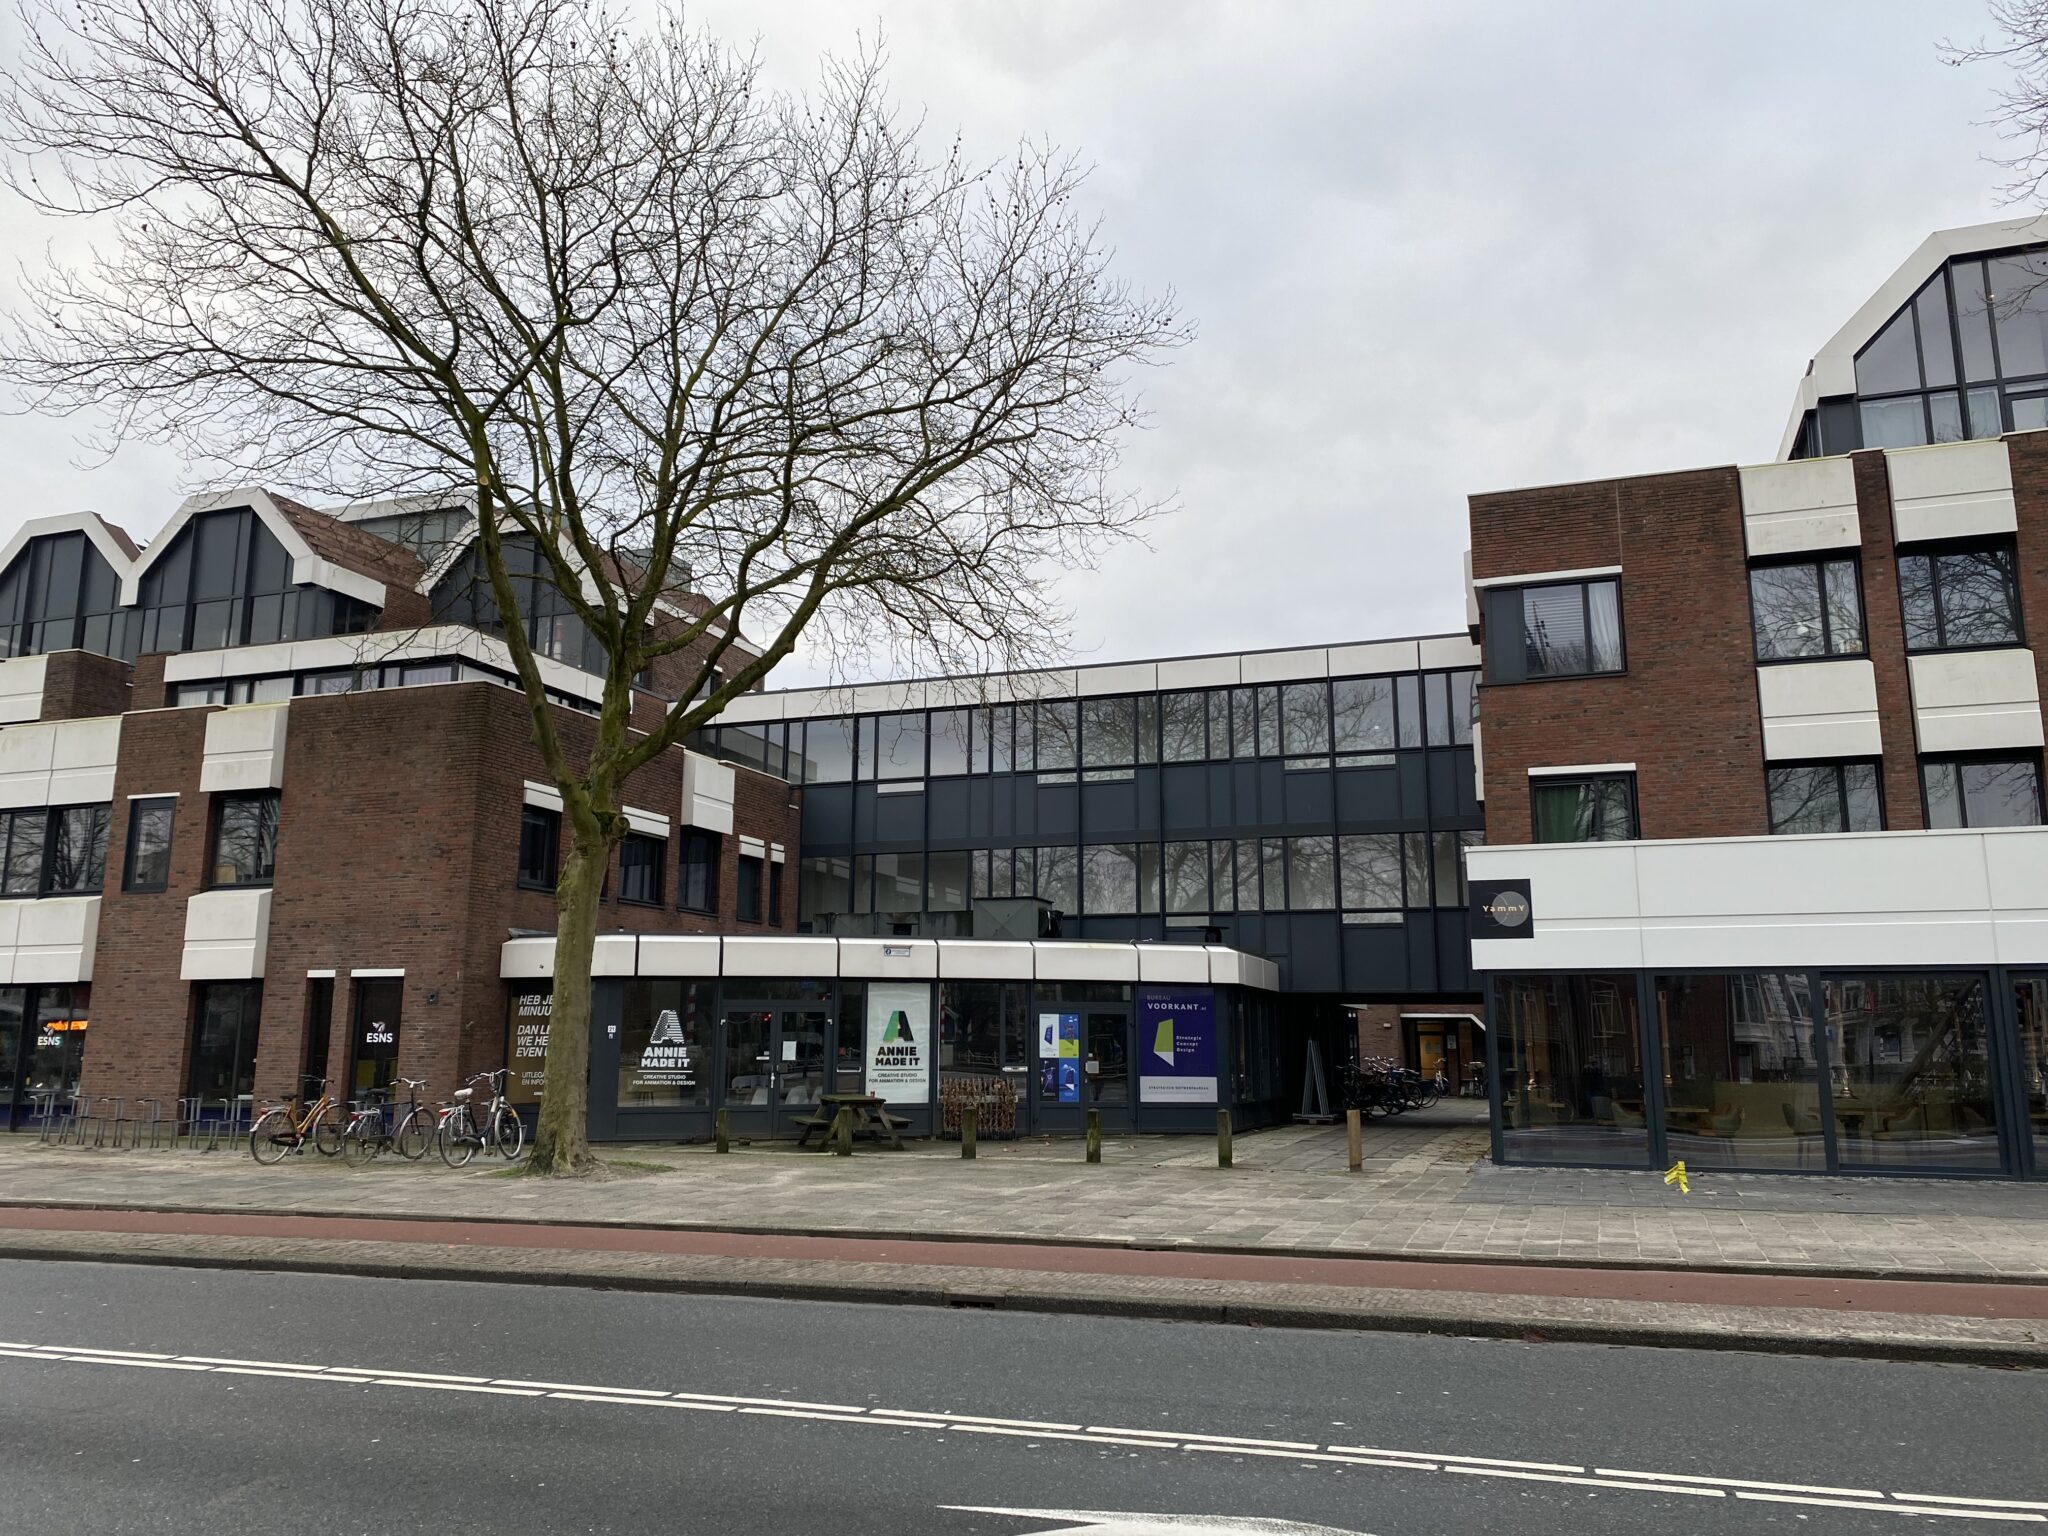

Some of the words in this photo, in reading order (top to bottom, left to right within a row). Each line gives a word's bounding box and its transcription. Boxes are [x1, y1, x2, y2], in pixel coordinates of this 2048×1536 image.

[519, 995, 541, 1005] HEB
[518, 1006, 552, 1016] MINUU
[517, 1025, 539, 1035] DAN
[37, 1037, 61, 1046] ESNS
[366, 1033, 393, 1043] ESNS
[517, 1036, 533, 1046] WE
[516, 1047, 543, 1057] EVEN
[643, 1047, 687, 1057] ANNIE
[877, 1047, 917, 1056] ANNIE
[641, 1058, 675, 1068] MADE
[677, 1058, 690, 1068] IT
[875, 1058, 907, 1066] MADE
[909, 1058, 920, 1066] IT
